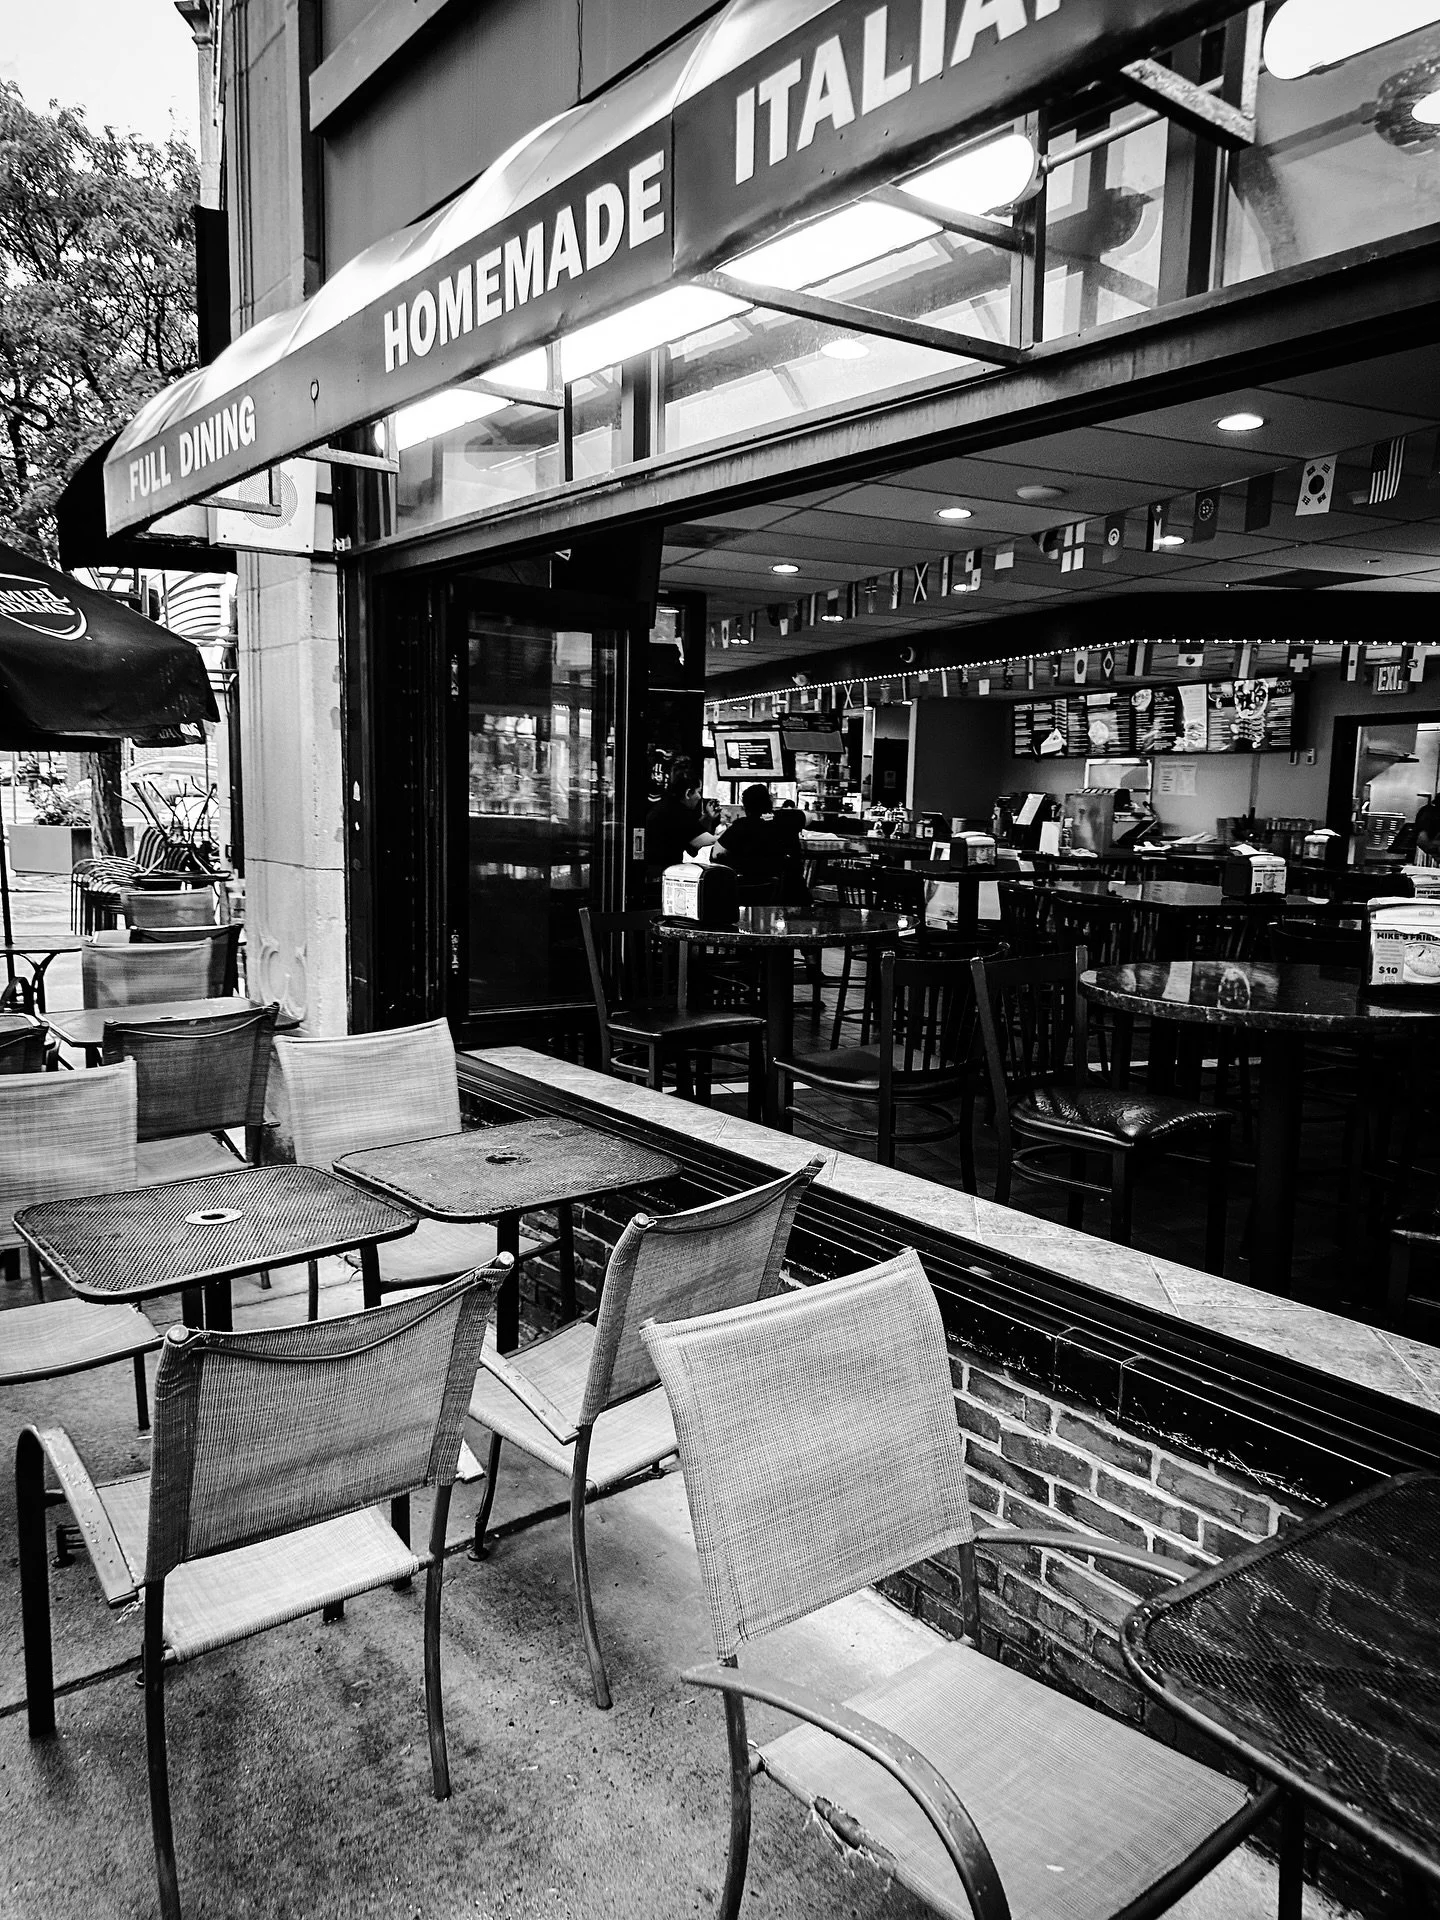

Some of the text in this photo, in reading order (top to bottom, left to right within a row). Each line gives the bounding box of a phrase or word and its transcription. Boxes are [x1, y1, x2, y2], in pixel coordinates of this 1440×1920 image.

[129, 0, 1062, 501] FULL DINING HOMEMADE ITALIA
[1378, 965, 1398, 974] $10
